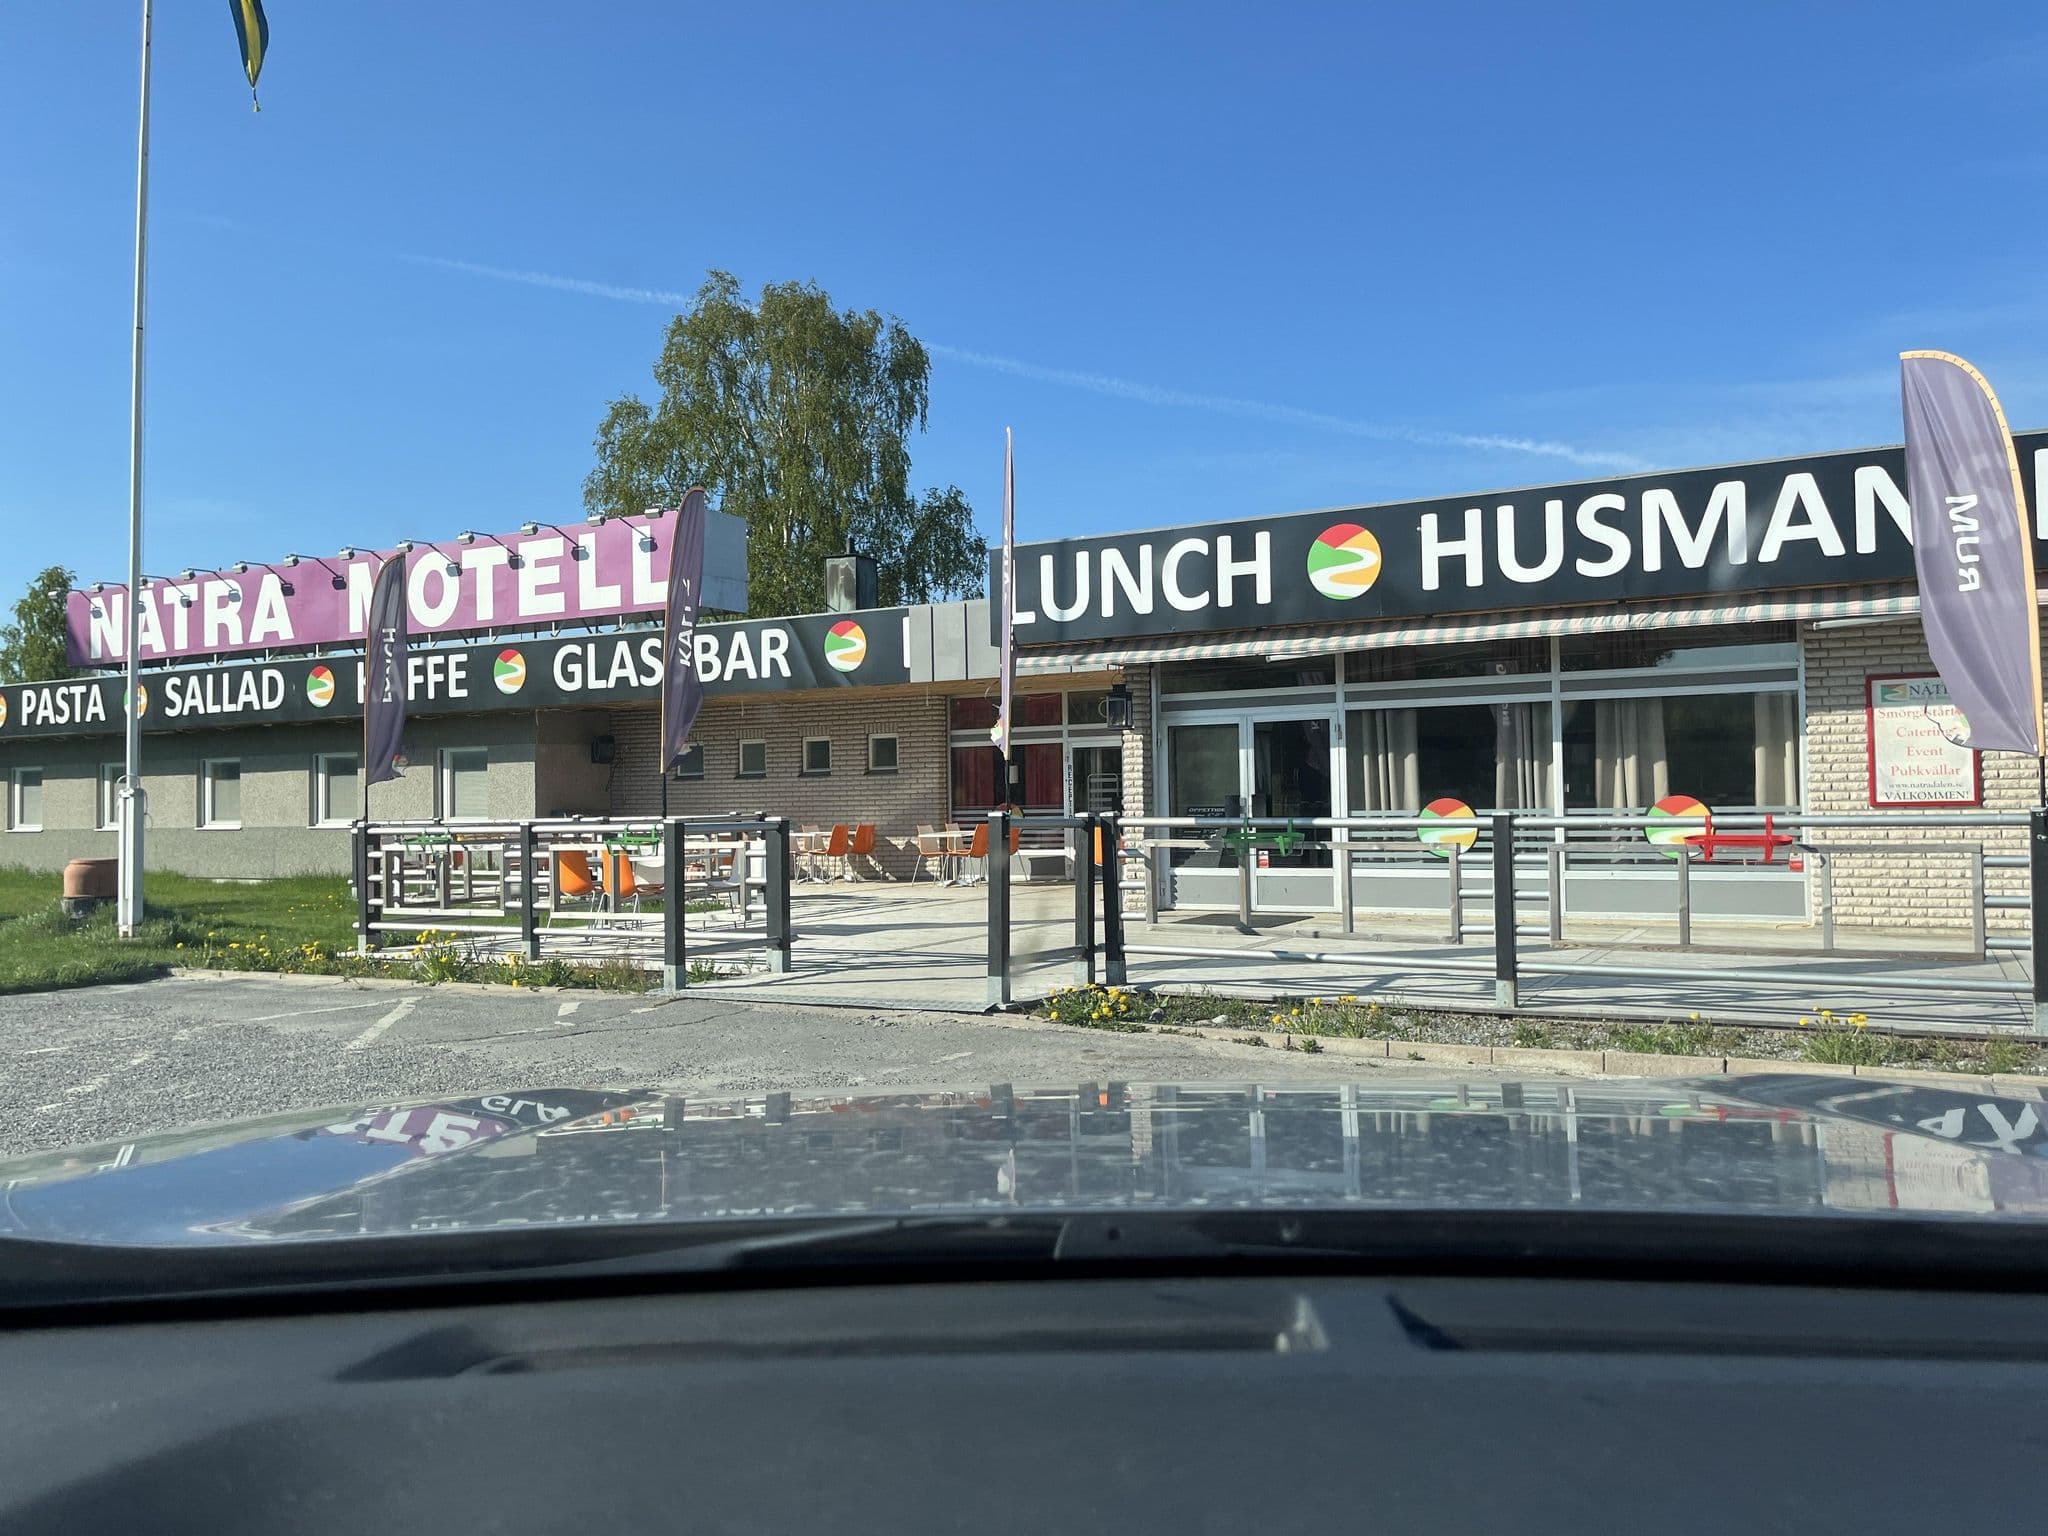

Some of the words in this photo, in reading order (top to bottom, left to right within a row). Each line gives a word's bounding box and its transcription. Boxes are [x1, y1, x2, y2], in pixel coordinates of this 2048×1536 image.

[1420, 449, 2048, 591] HUSMAN
[90, 573, 295, 659] NÄTRA
[21, 684, 106, 726] PASTA
[165, 669, 285, 718] SALLAD
[357, 654, 469, 704] FFE
[553, 629, 792, 692] GLASBAR
[1908, 681, 1949, 697] NÄT
[1906, 746, 1944, 757] Event
